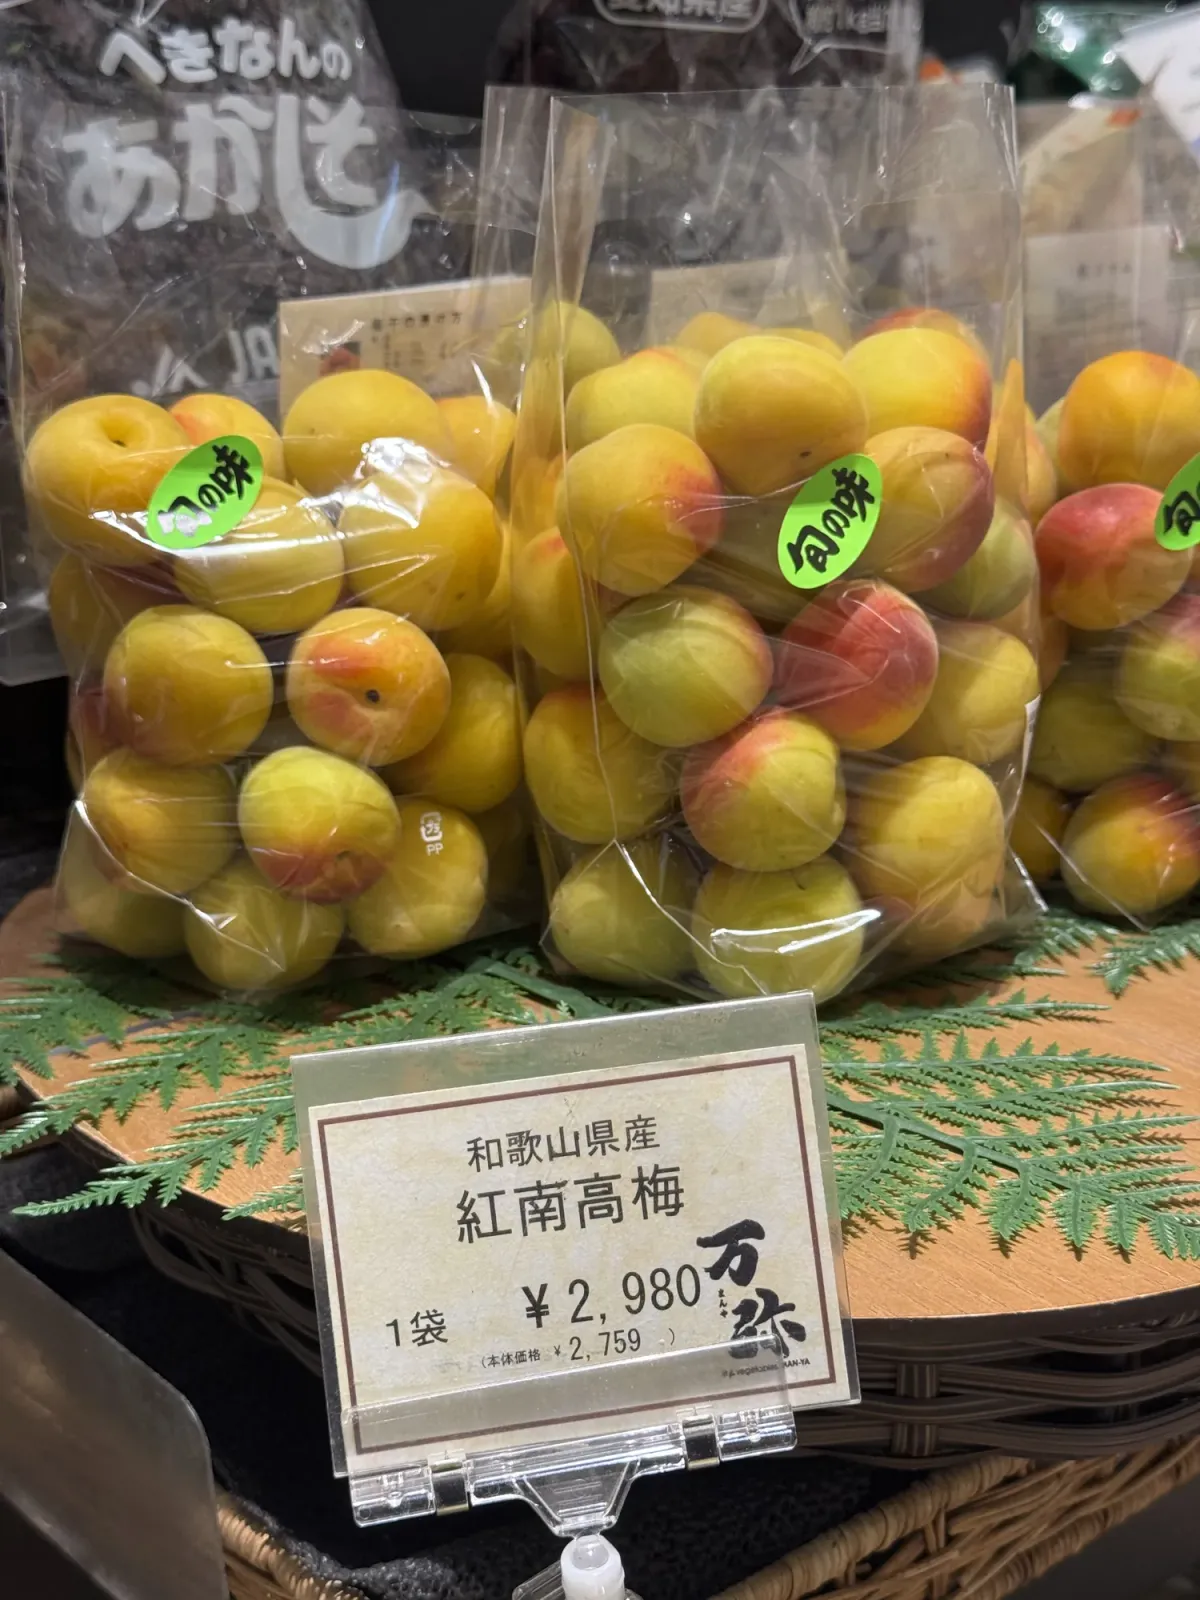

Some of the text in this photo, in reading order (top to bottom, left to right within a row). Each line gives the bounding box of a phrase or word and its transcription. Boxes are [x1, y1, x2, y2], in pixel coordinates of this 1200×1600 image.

[100, 17, 353, 85] へきなんの
[61, 93, 438, 270] あかしそ
[156, 444, 254, 537] 旬の味
[786, 467, 875, 575] 旬の味
[426, 842, 444, 857] PP
[466, 1114, 661, 1173] 和歌山県産
[456, 1163, 685, 1244] 紅南高梅
[385, 1308, 449, 1348] 1袋
